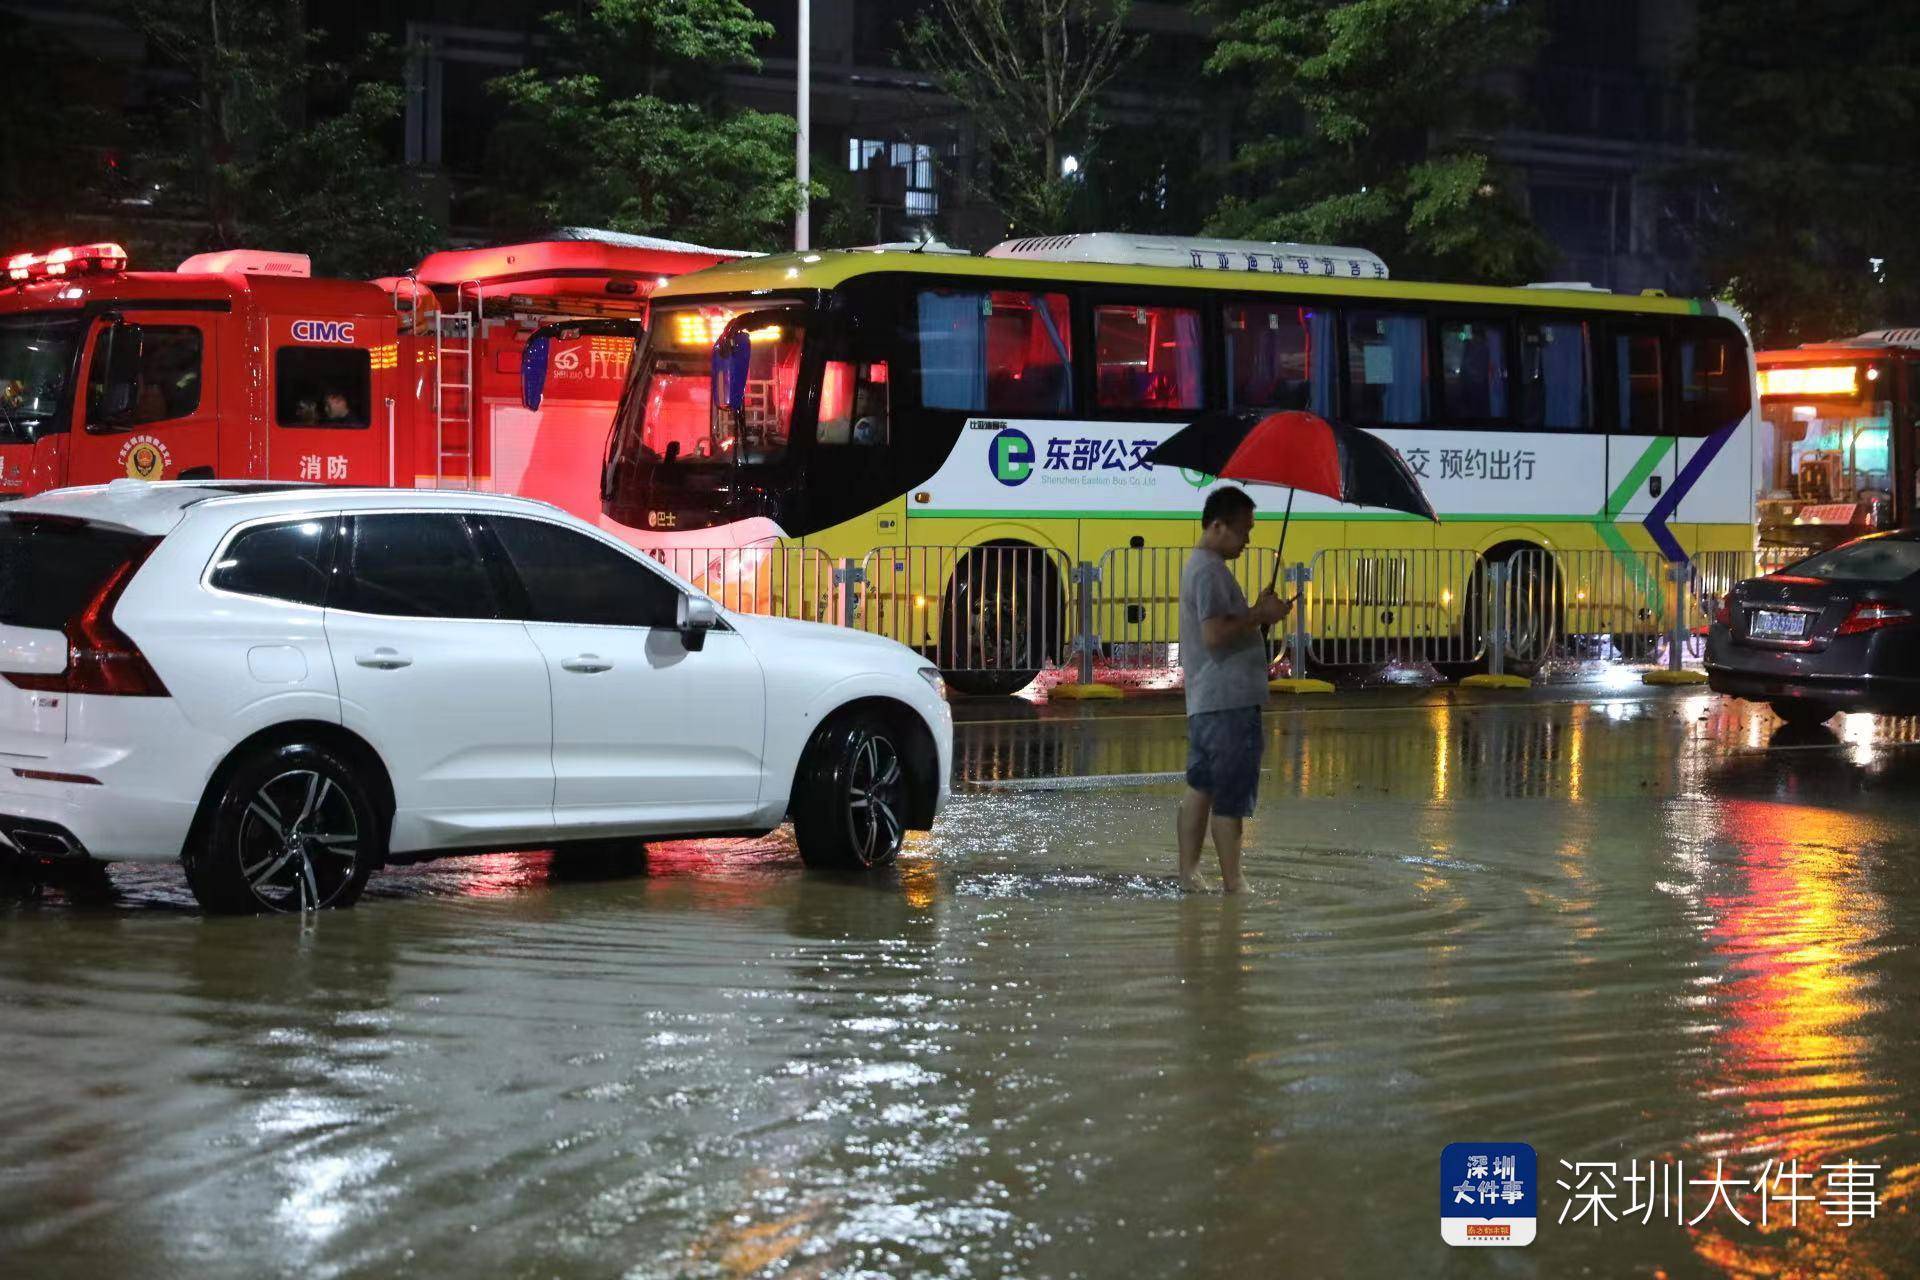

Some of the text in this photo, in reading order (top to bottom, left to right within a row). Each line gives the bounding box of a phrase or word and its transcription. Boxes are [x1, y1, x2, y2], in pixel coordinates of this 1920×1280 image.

[291, 320, 355, 343] CIMC
[299, 455, 348, 480] 消防
[1043, 437, 1158, 472] 东部公交
[1440, 448, 1536, 481] 预约出行
